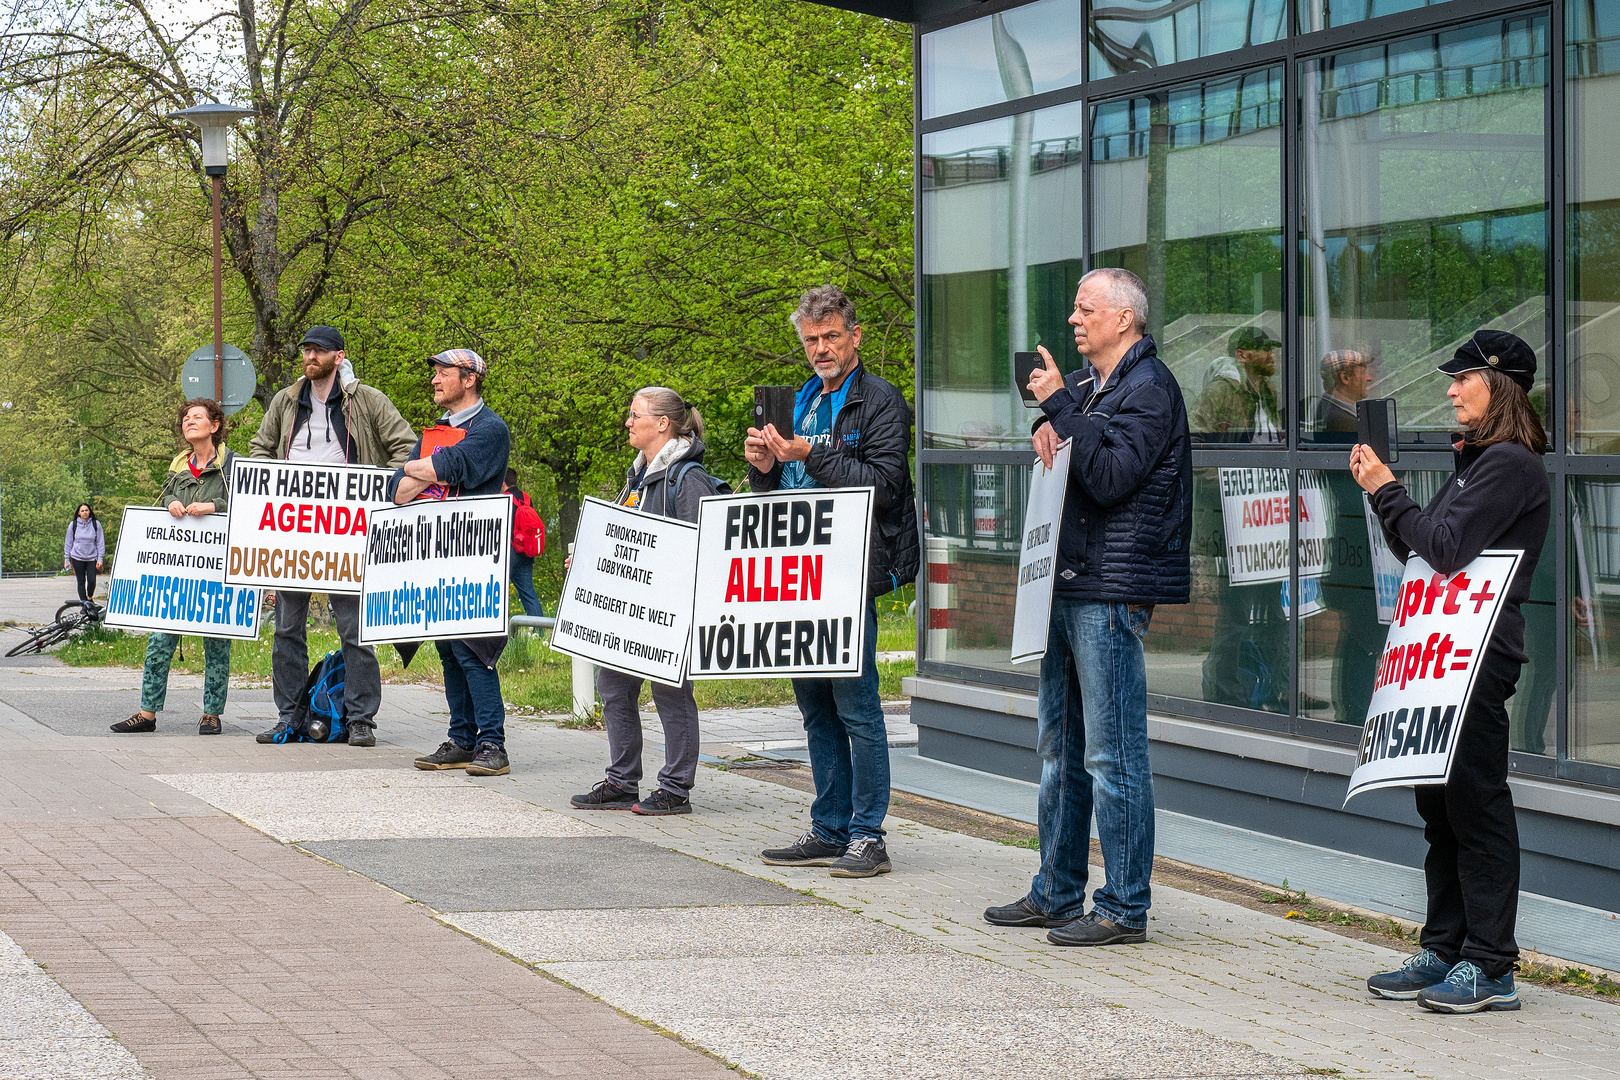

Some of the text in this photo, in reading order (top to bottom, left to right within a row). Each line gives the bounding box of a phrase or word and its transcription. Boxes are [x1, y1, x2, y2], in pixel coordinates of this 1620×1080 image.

[237, 467, 270, 496] WIR
[276, 469, 340, 500] HABEN
[258, 502, 367, 536] AGENDA
[605, 522, 658, 549] DEMOKRATIE
[724, 499, 835, 551] FRIEDE
[367, 511, 502, 566] Polizisten für Aufklärung
[613, 543, 640, 563] STATT
[137, 550, 224, 570] INFORMATIONE
[229, 546, 364, 583] DURCHSCHAU
[596, 556, 653, 586] LOBBYKRATIE
[724, 554, 823, 603] ALLEN
[235, 587, 255, 628] de
[366, 574, 500, 631] www.echte-polizisten.de
[574, 586, 676, 628] GELD REGIERT DIE WELT
[560, 618, 573, 636] WIR
[573, 623, 602, 646] STEHEN
[603, 631, 621, 651] FÜR
[699, 614, 853, 671] VÖLKERN!
